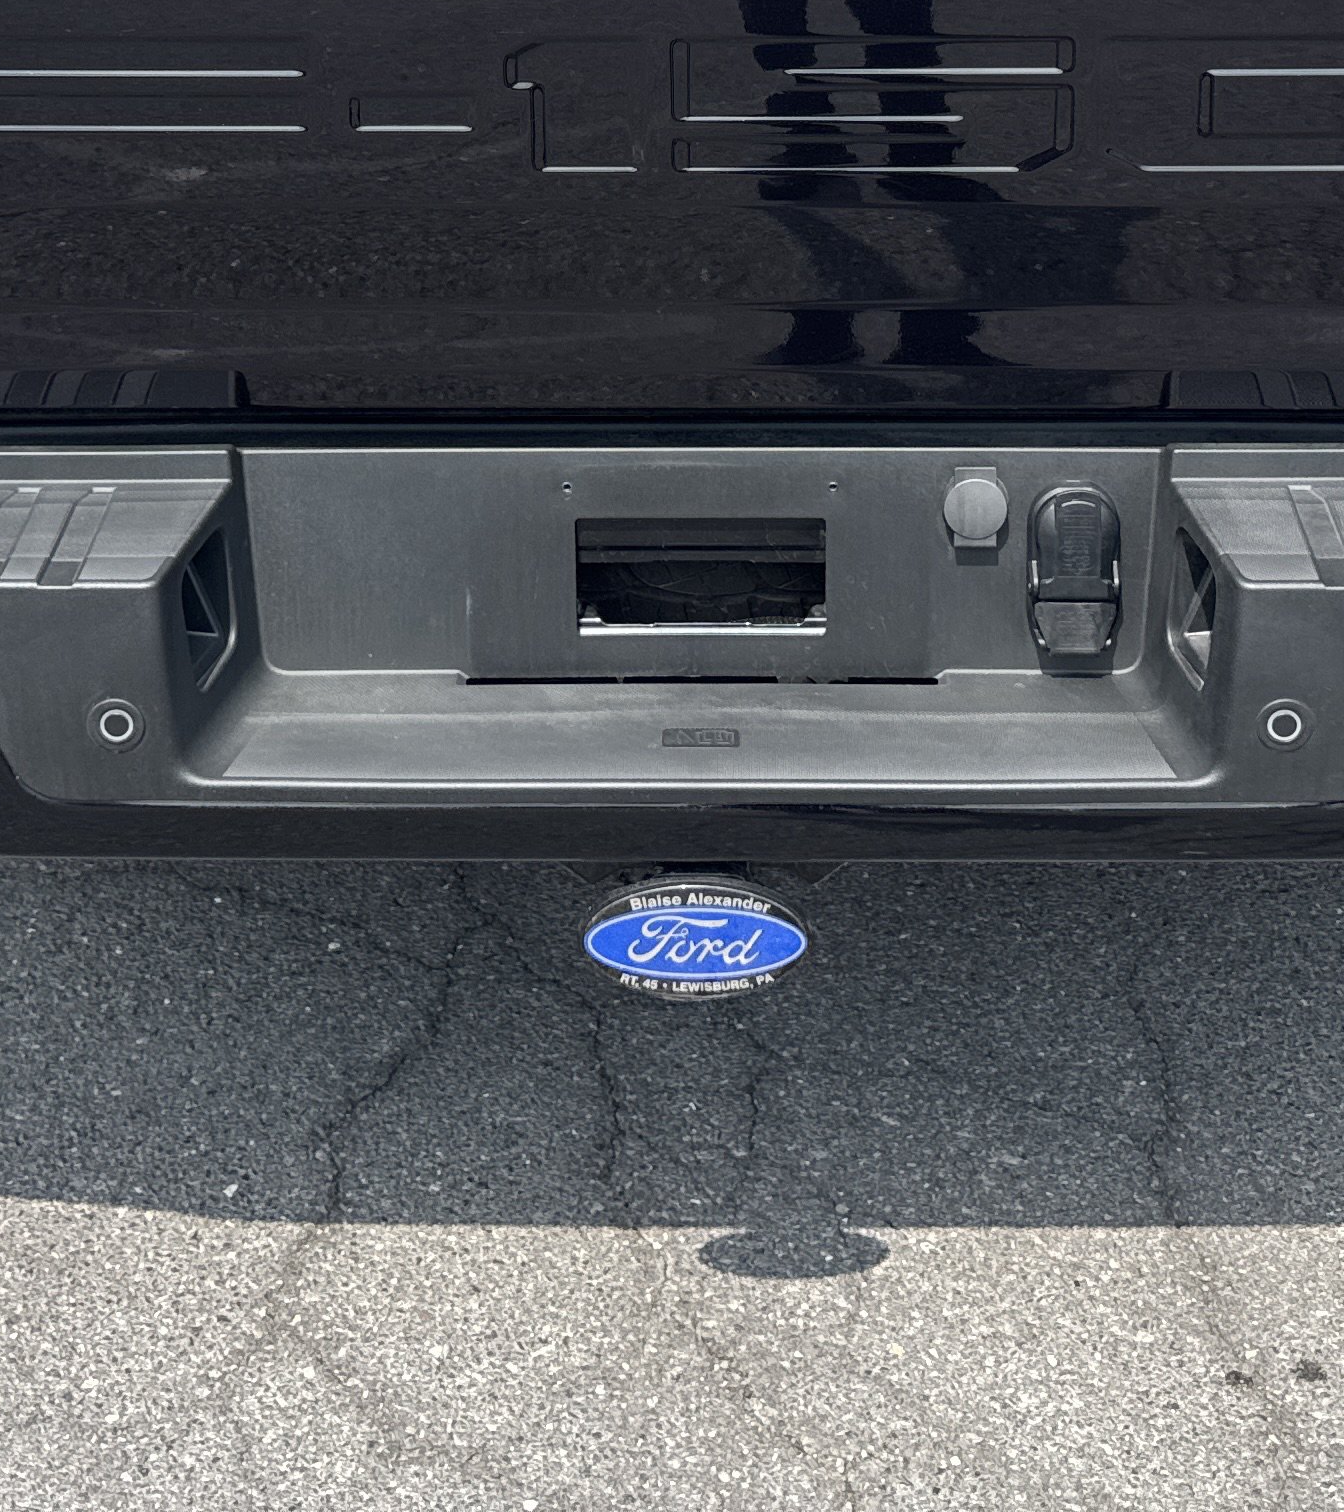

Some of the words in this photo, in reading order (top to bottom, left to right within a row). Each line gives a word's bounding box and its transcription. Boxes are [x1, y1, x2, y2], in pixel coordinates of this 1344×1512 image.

[629, 892, 682, 912] Blaise
[686, 892, 772, 914] Alexander
[627, 914, 763, 966] Ford
[619, 972, 640, 988] RT.
[642, 979, 659, 989] 45
[672, 979, 754, 993] LEWISBURG,
[756, 973, 776, 986] PA
